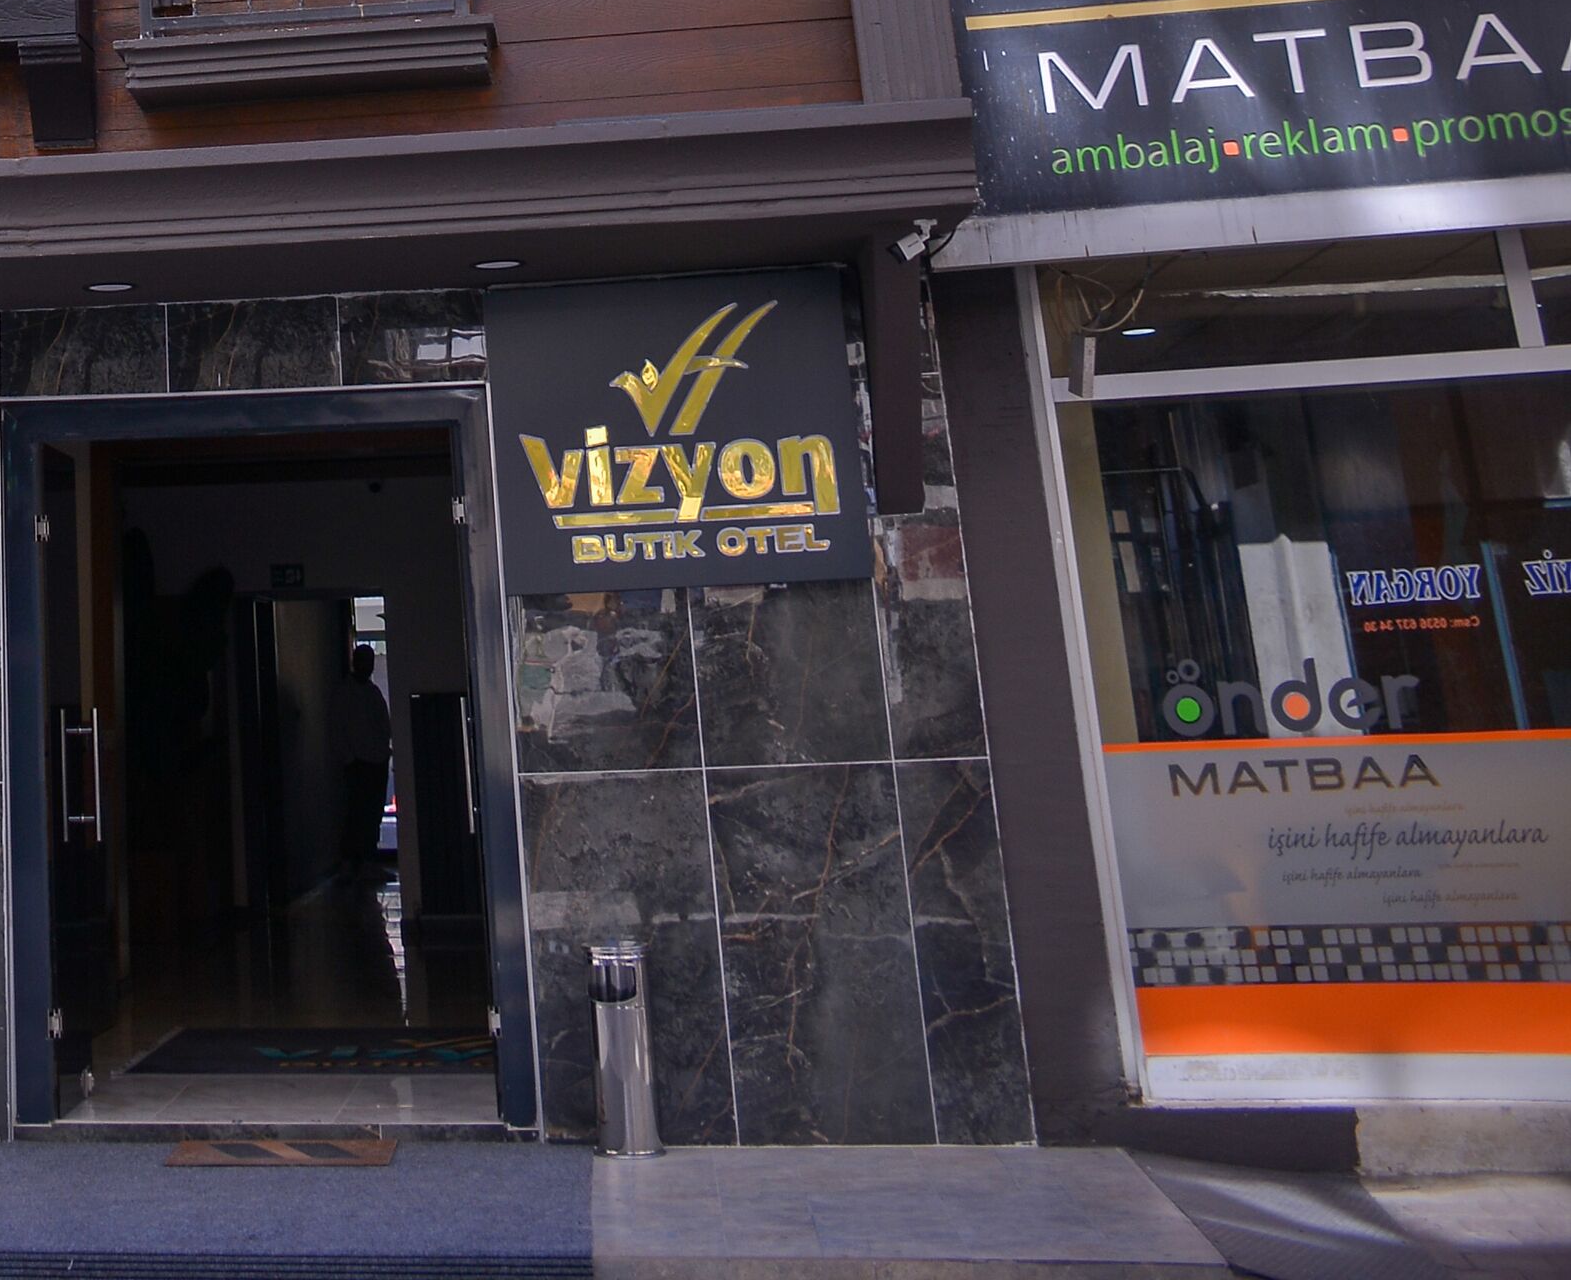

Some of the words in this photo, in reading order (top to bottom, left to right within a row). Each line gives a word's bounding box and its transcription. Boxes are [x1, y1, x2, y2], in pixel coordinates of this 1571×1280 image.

[716, 523, 831, 557] OTEL
[1162, 657, 1420, 737] önder
[1168, 754, 1440, 797] MATBAA
[1268, 826, 1321, 856] işini
[1324, 822, 1391, 860] hafife
[1395, 819, 1549, 857] almayanlara
